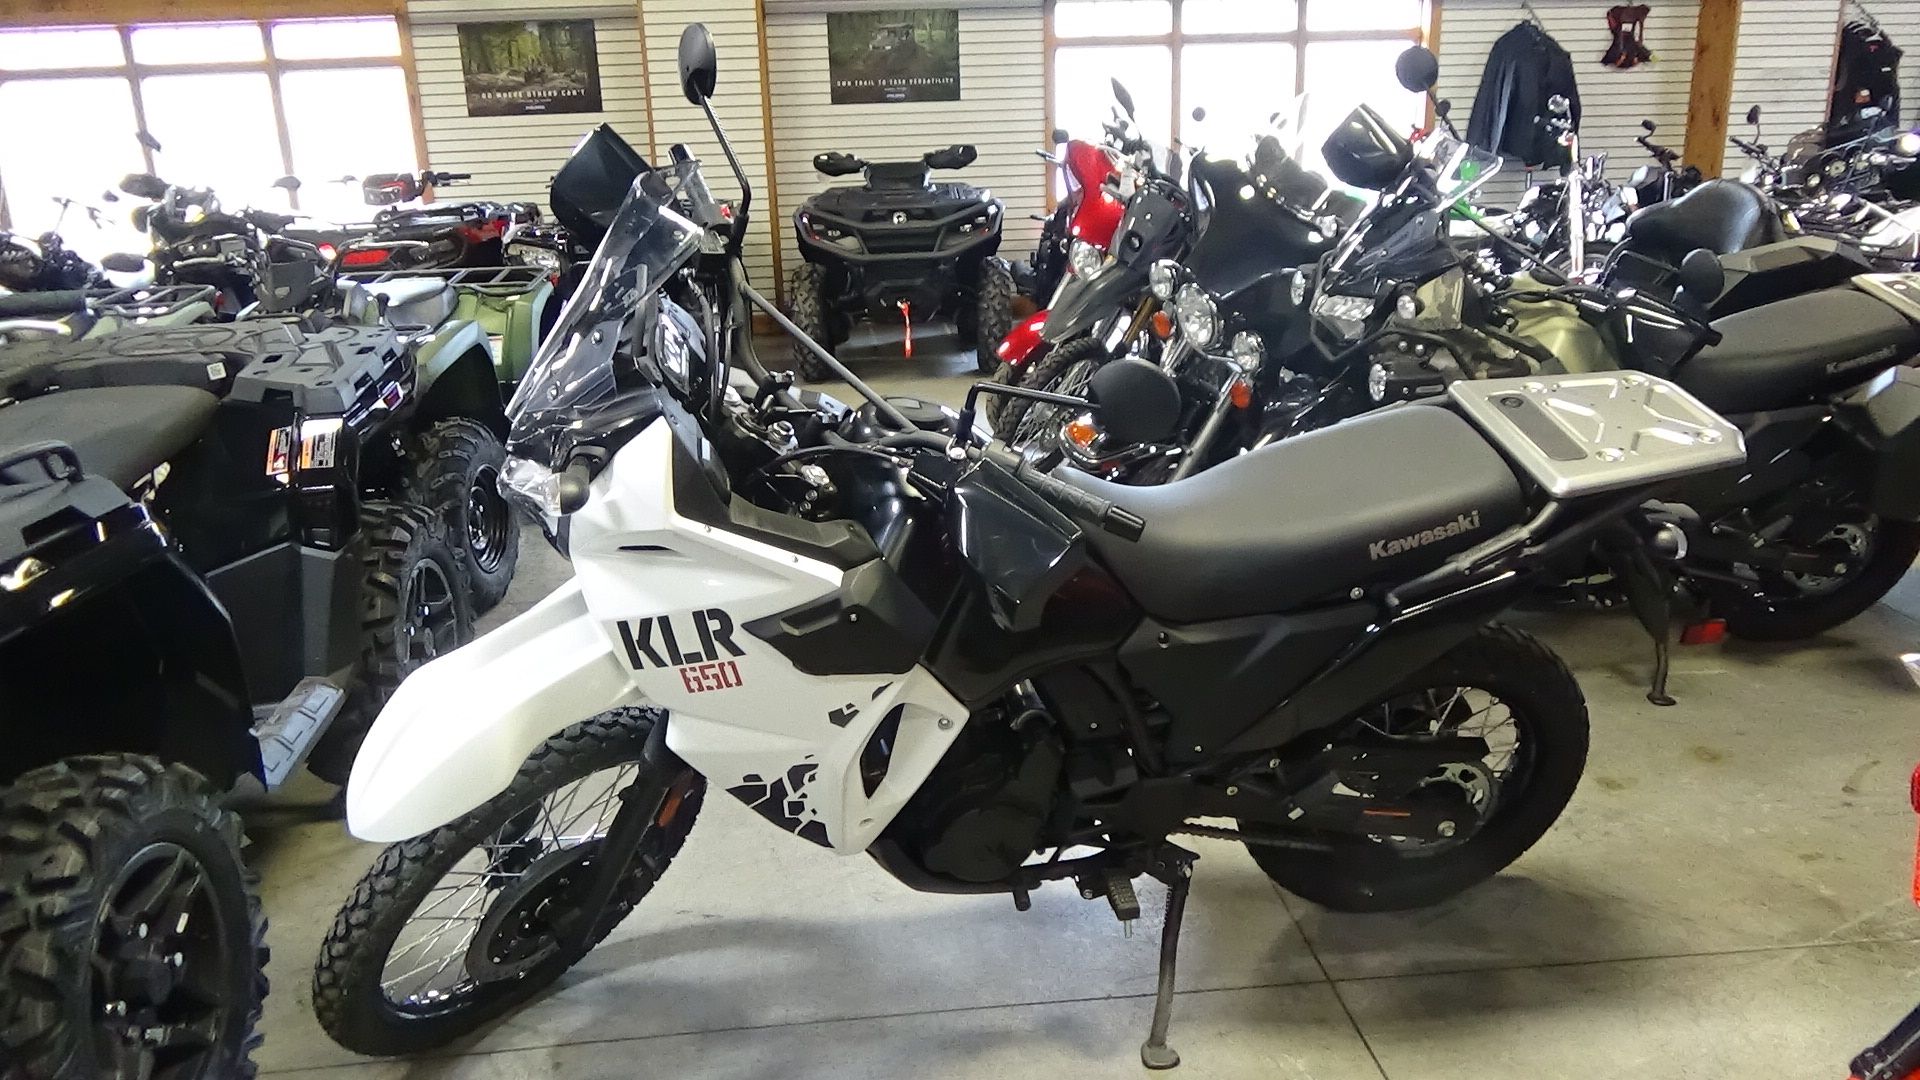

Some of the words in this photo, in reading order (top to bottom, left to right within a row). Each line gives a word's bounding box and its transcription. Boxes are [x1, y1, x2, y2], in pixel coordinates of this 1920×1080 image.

[527, 90, 557, 98] OTHERS
[561, 88, 586, 97] CAN'T
[1369, 510, 1480, 560] Kawasaki
[616, 608, 746, 670] KLR
[679, 661, 743, 694] 650
